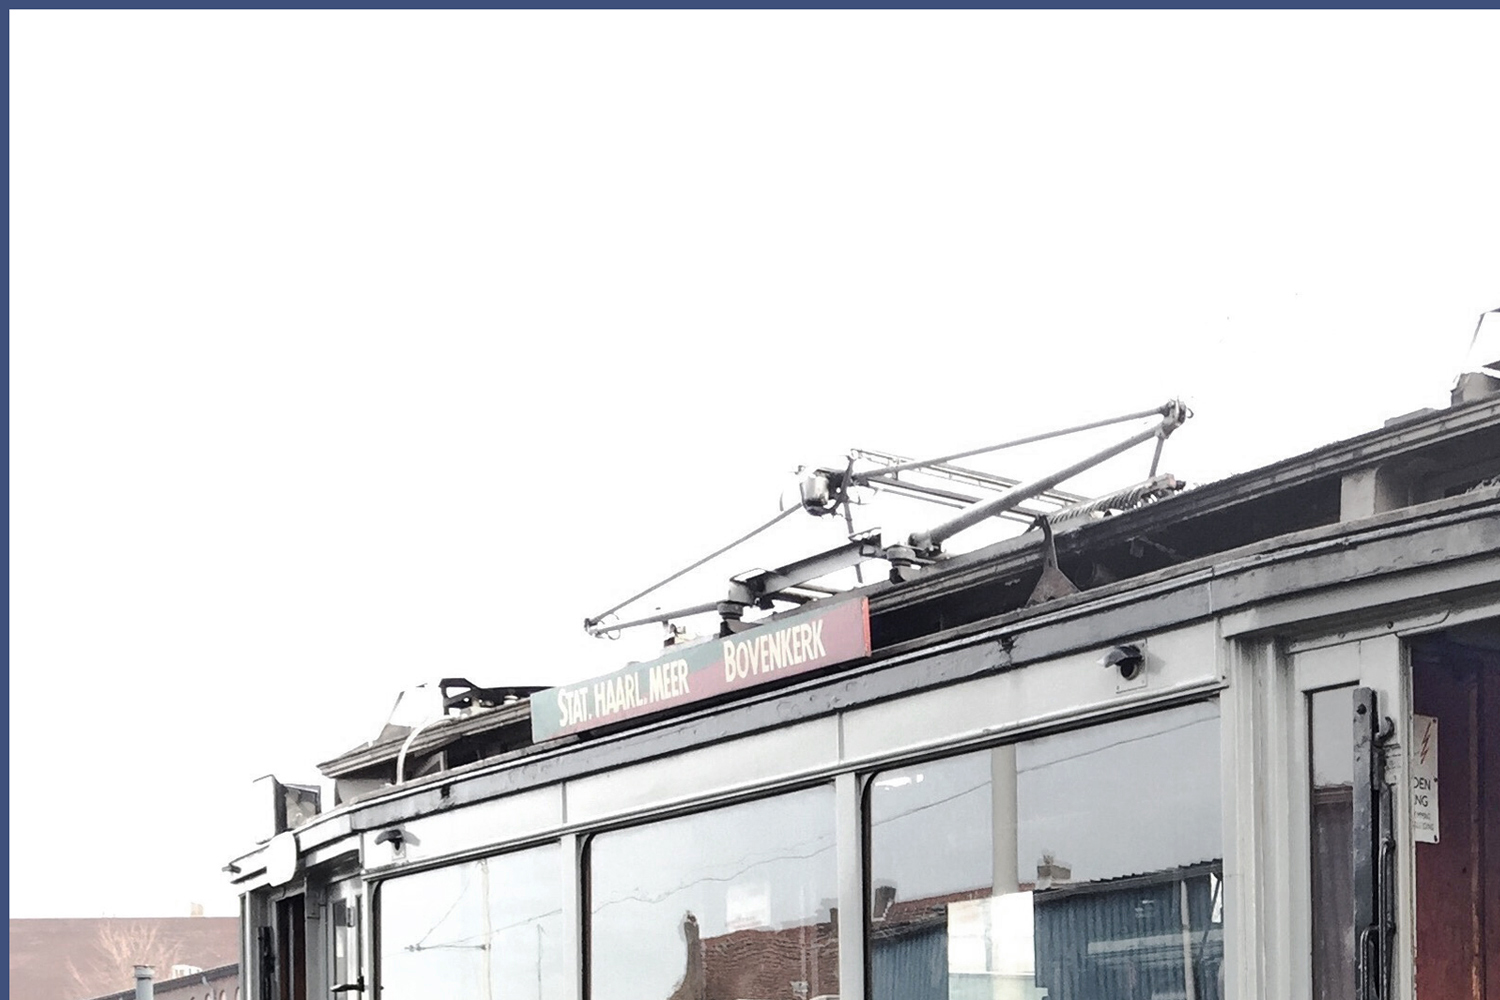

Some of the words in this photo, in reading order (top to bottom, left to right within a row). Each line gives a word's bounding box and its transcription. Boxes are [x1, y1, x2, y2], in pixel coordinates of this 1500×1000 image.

[557, 687, 592, 727] STAT.
[648, 659, 690, 704] MEER
[723, 619, 827, 683] BOVENKERK
